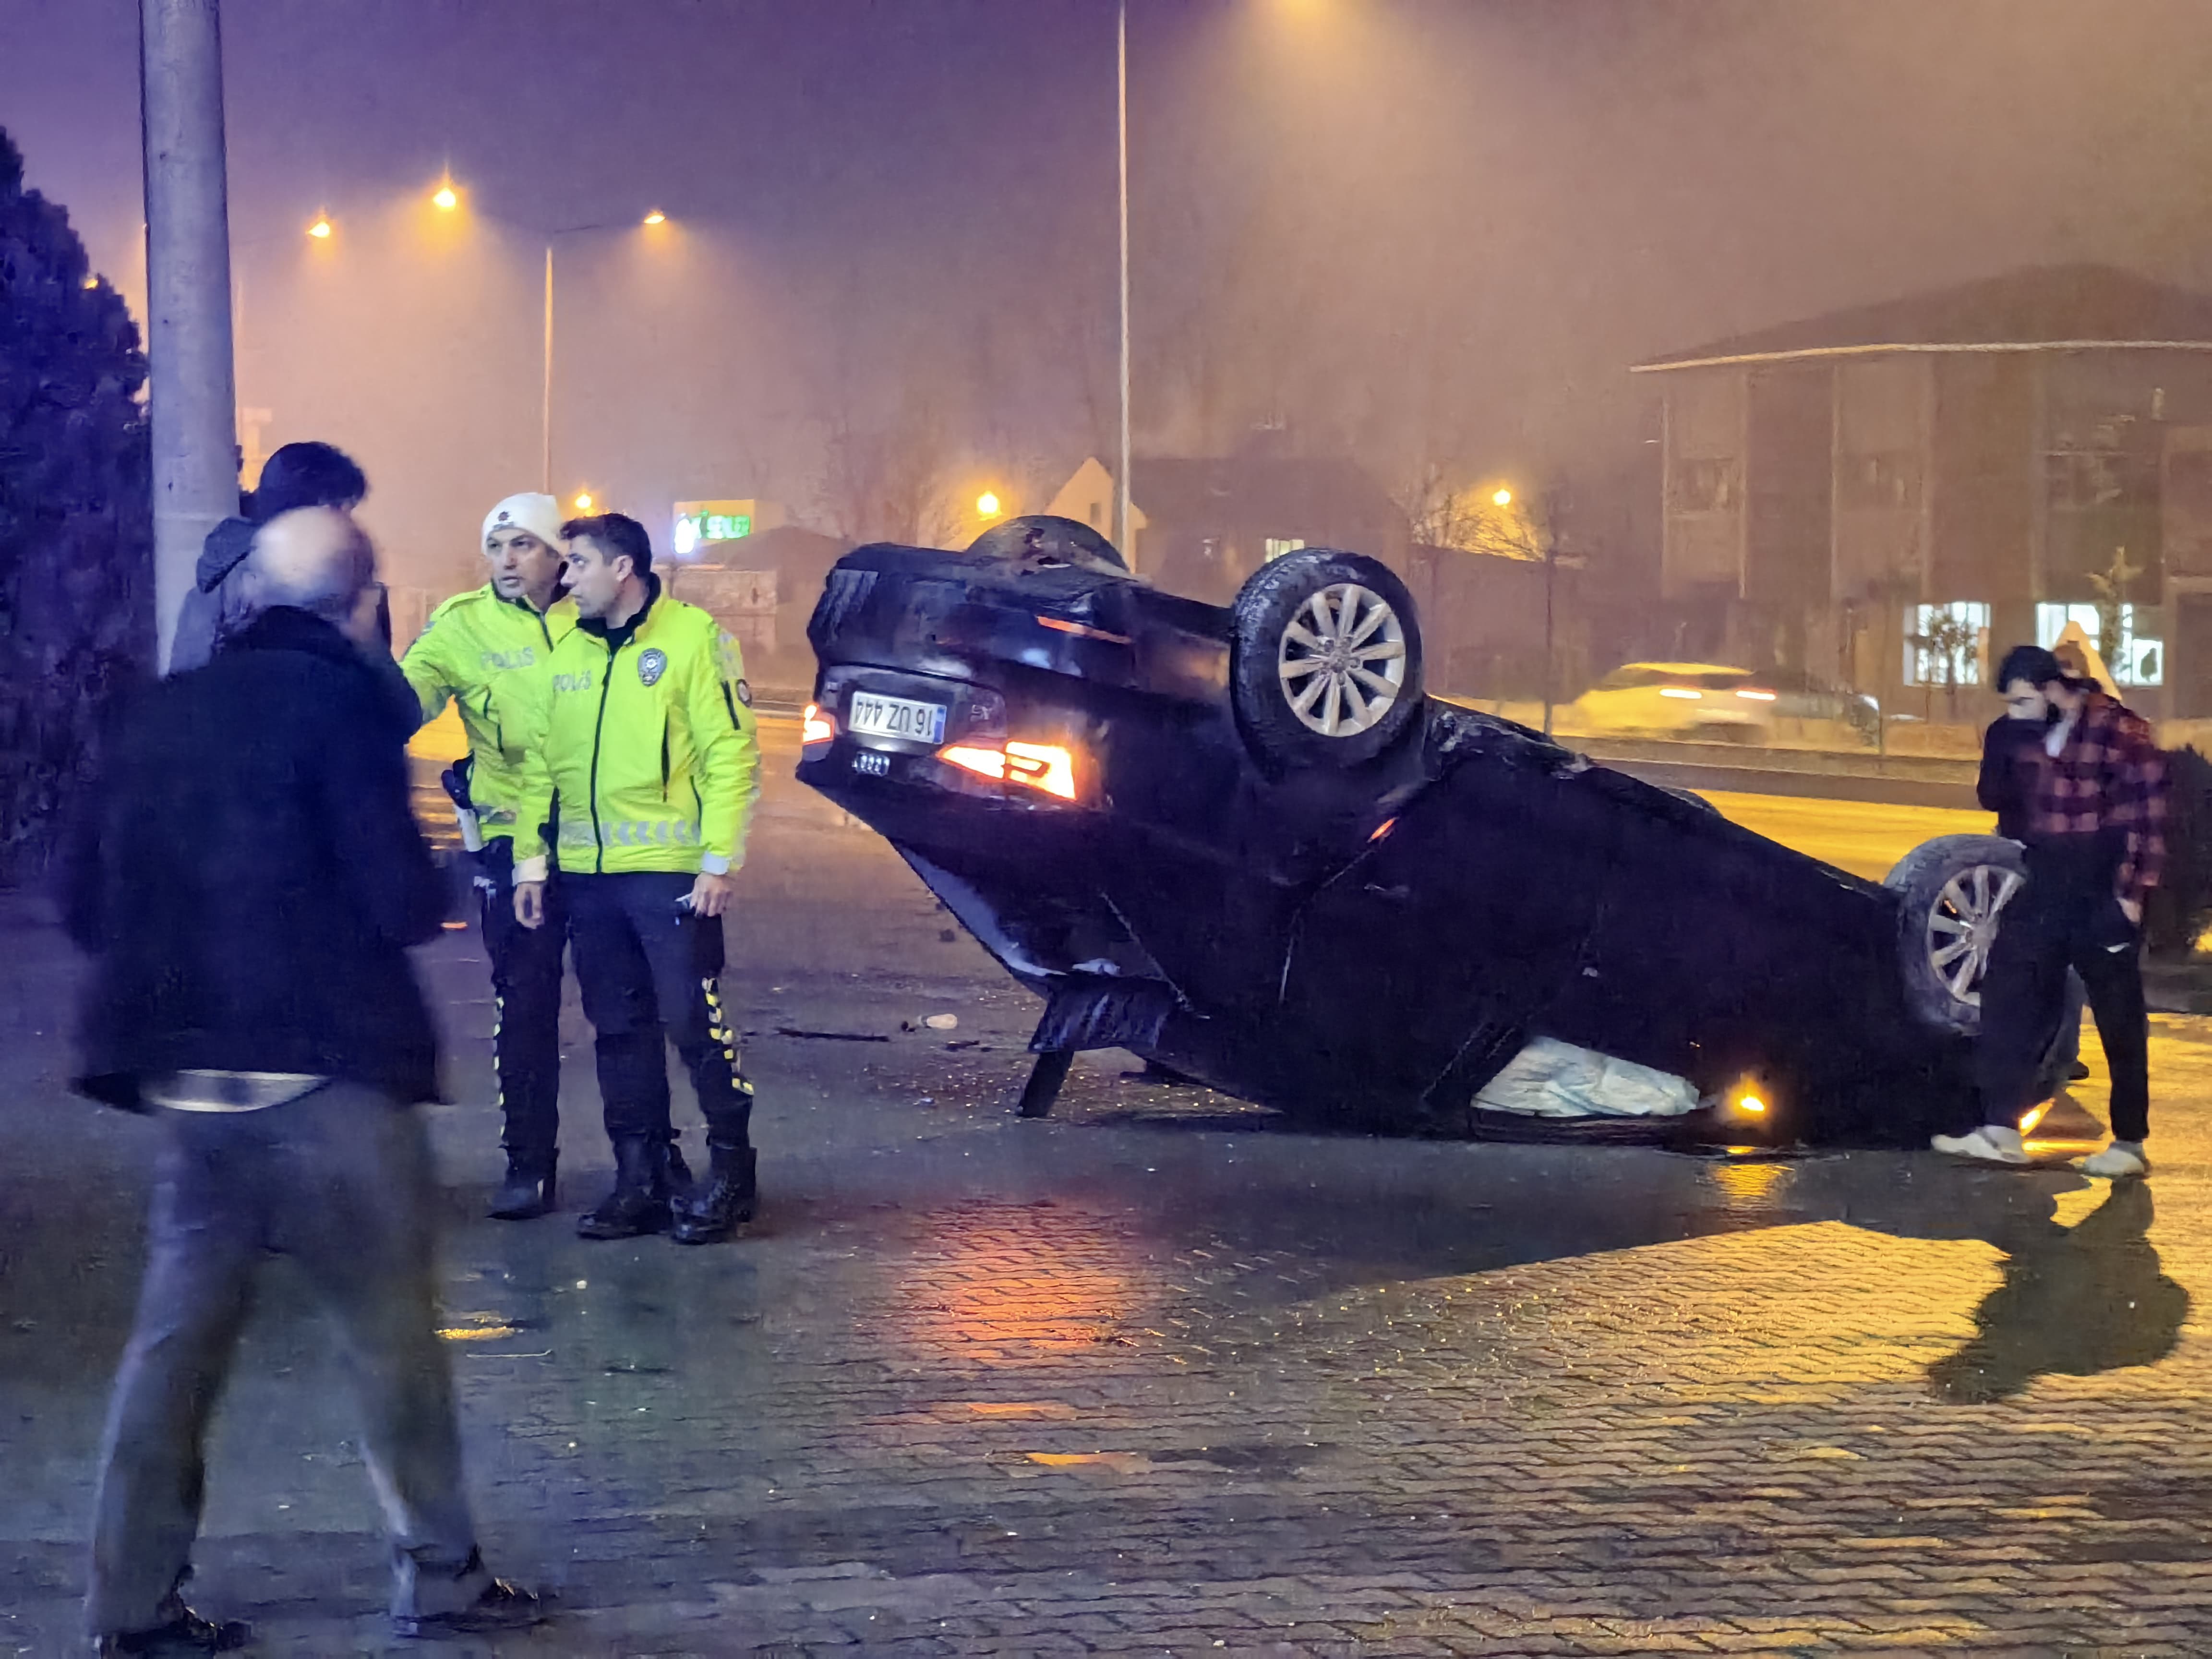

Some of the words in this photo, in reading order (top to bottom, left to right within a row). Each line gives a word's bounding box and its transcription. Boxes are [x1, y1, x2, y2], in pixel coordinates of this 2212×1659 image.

[854, 700, 884, 726] 444
[887, 704, 911, 731] UZ
[915, 709, 932, 735] 16
